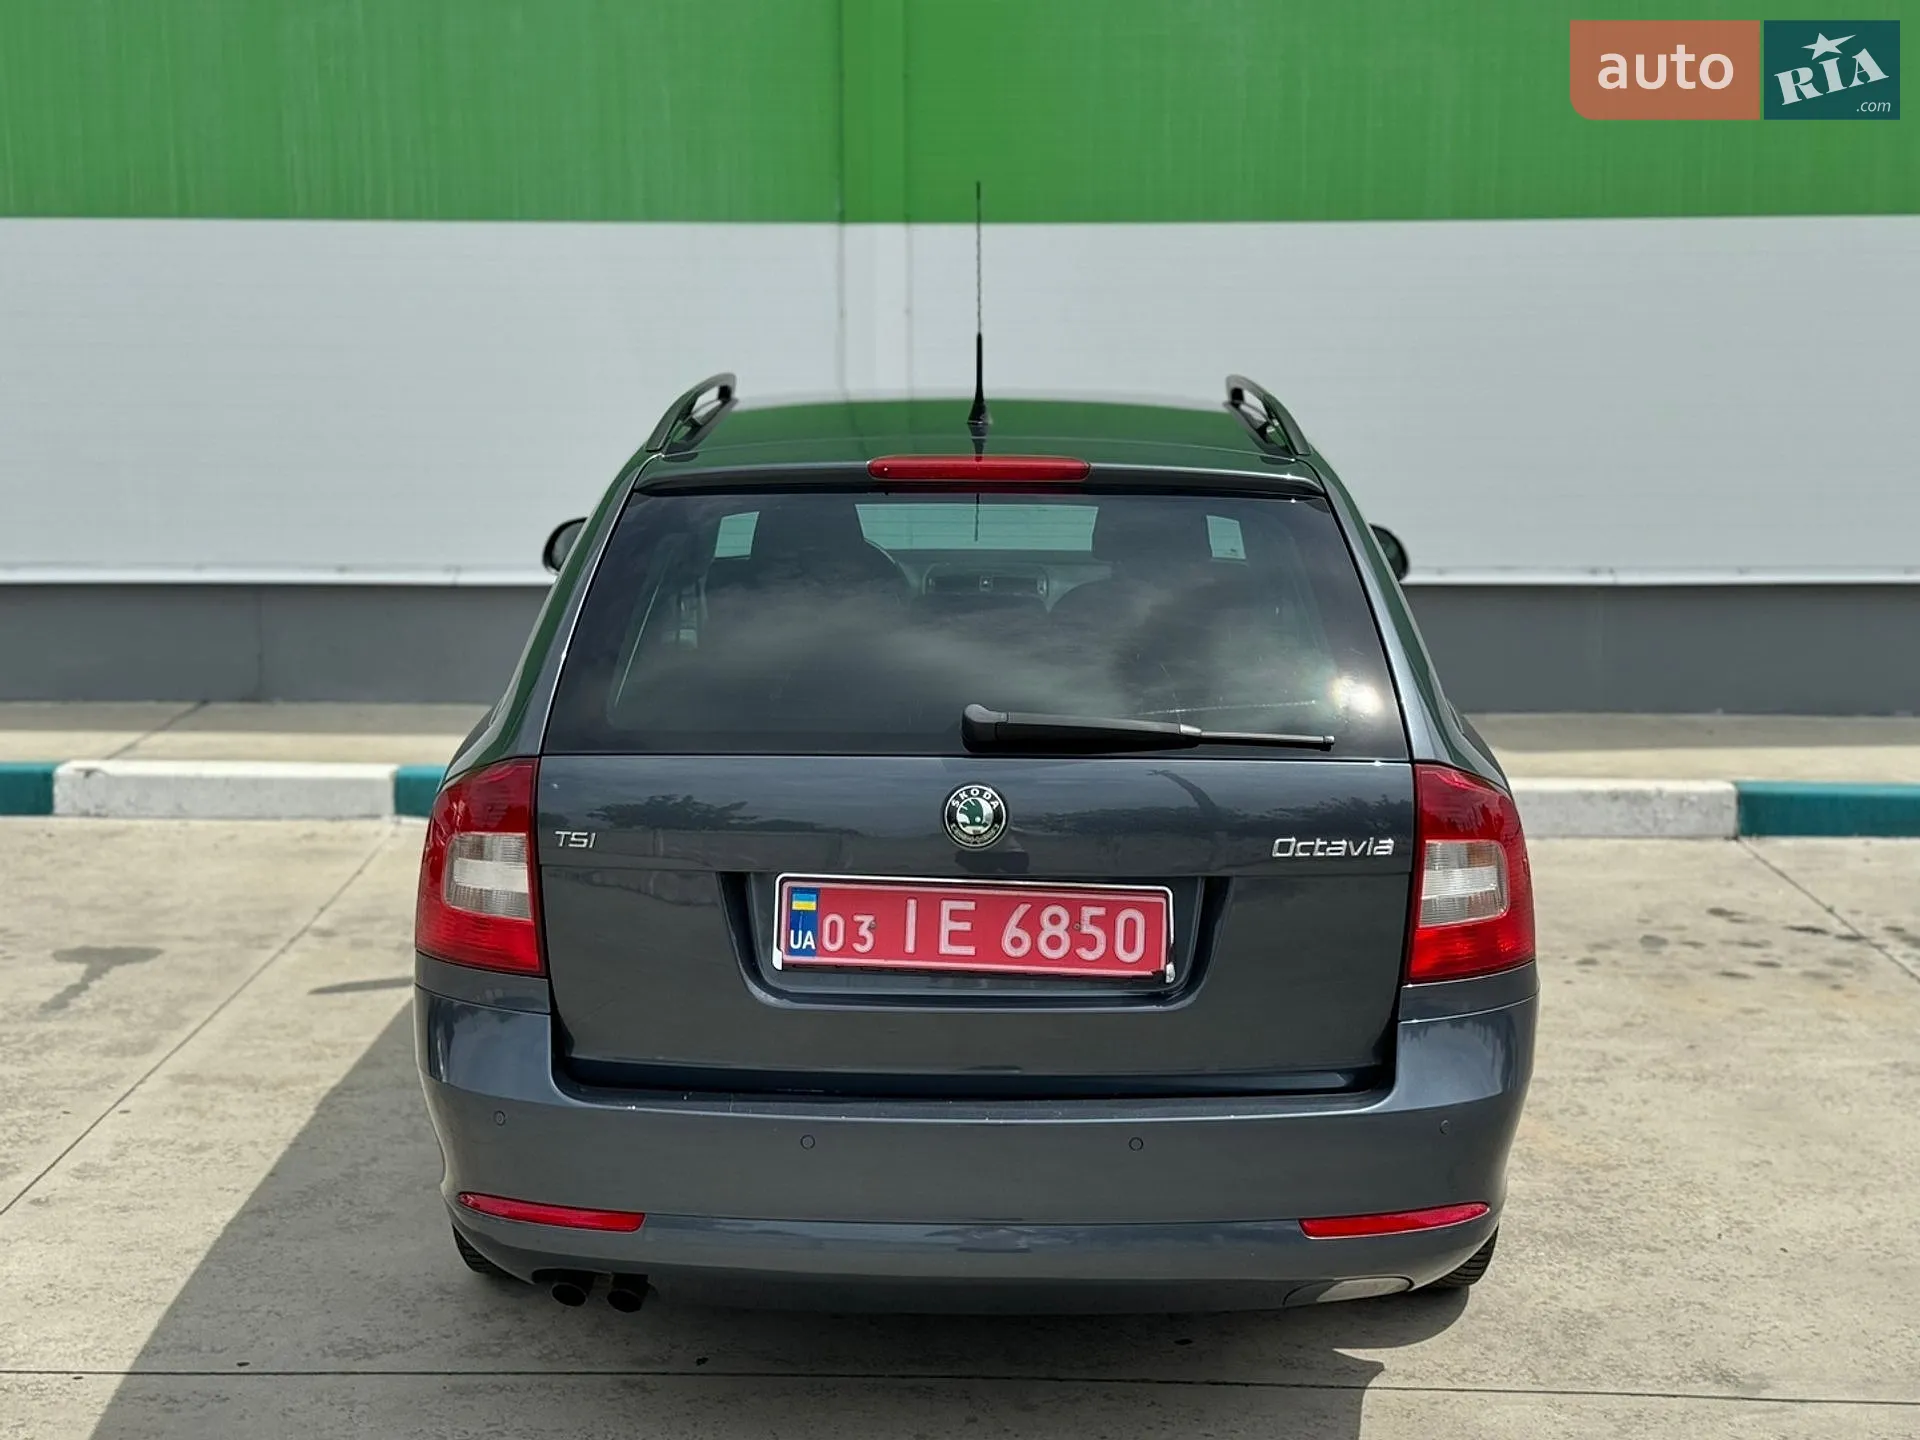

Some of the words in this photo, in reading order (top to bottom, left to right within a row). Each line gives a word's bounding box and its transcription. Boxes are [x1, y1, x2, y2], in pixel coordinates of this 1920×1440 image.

[555, 831, 596, 848] TSI
[1272, 836, 1395, 857] Octavia
[790, 929, 815, 950] UA
[822, 913, 875, 954] 03
[904, 898, 976, 956] IE
[1001, 903, 1146, 963] 6850
